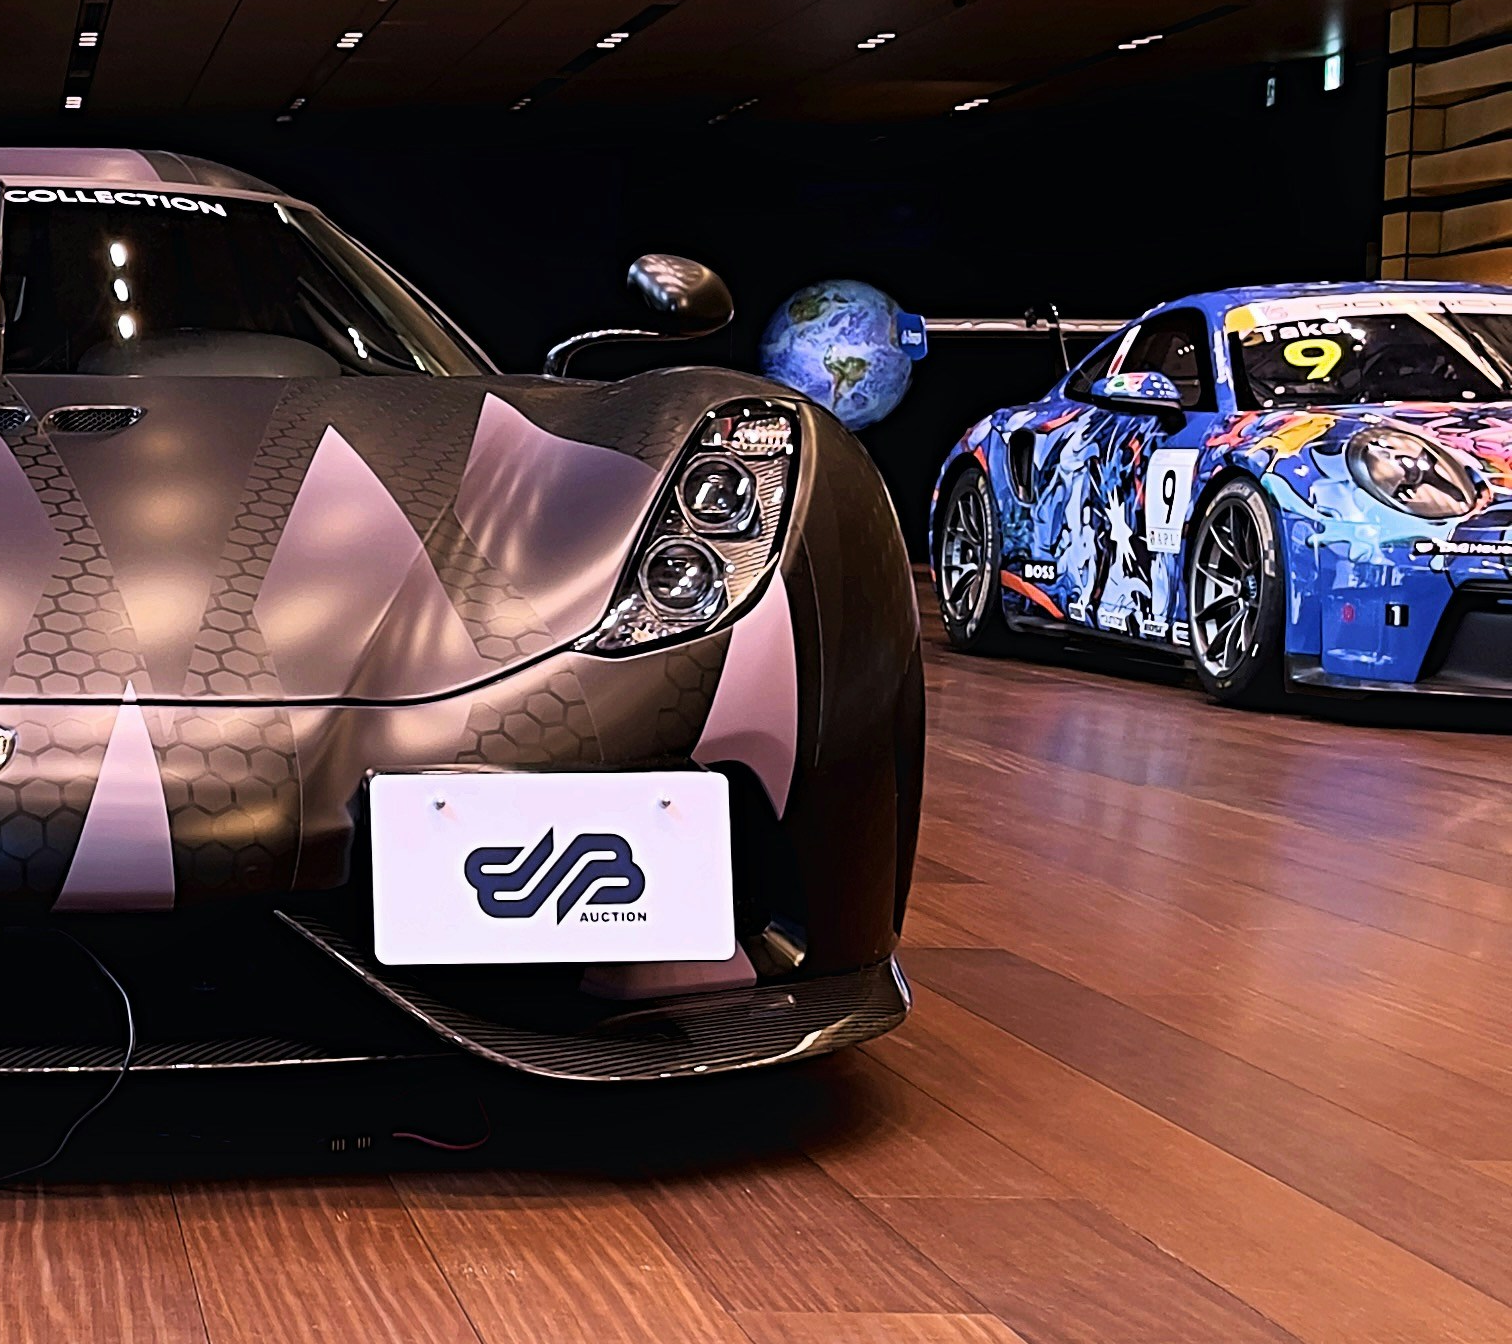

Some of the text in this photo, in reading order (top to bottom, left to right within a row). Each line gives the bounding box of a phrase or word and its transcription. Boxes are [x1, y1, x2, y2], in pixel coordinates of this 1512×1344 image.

[3, 188, 228, 217] COLLECTION
[1283, 338, 1342, 381] 9
[1162, 469, 1177, 525] 9
[1024, 564, 1055, 579] BOSS
[1391, 605, 1401, 626] 1
[579, 911, 648, 923] AUCTION
